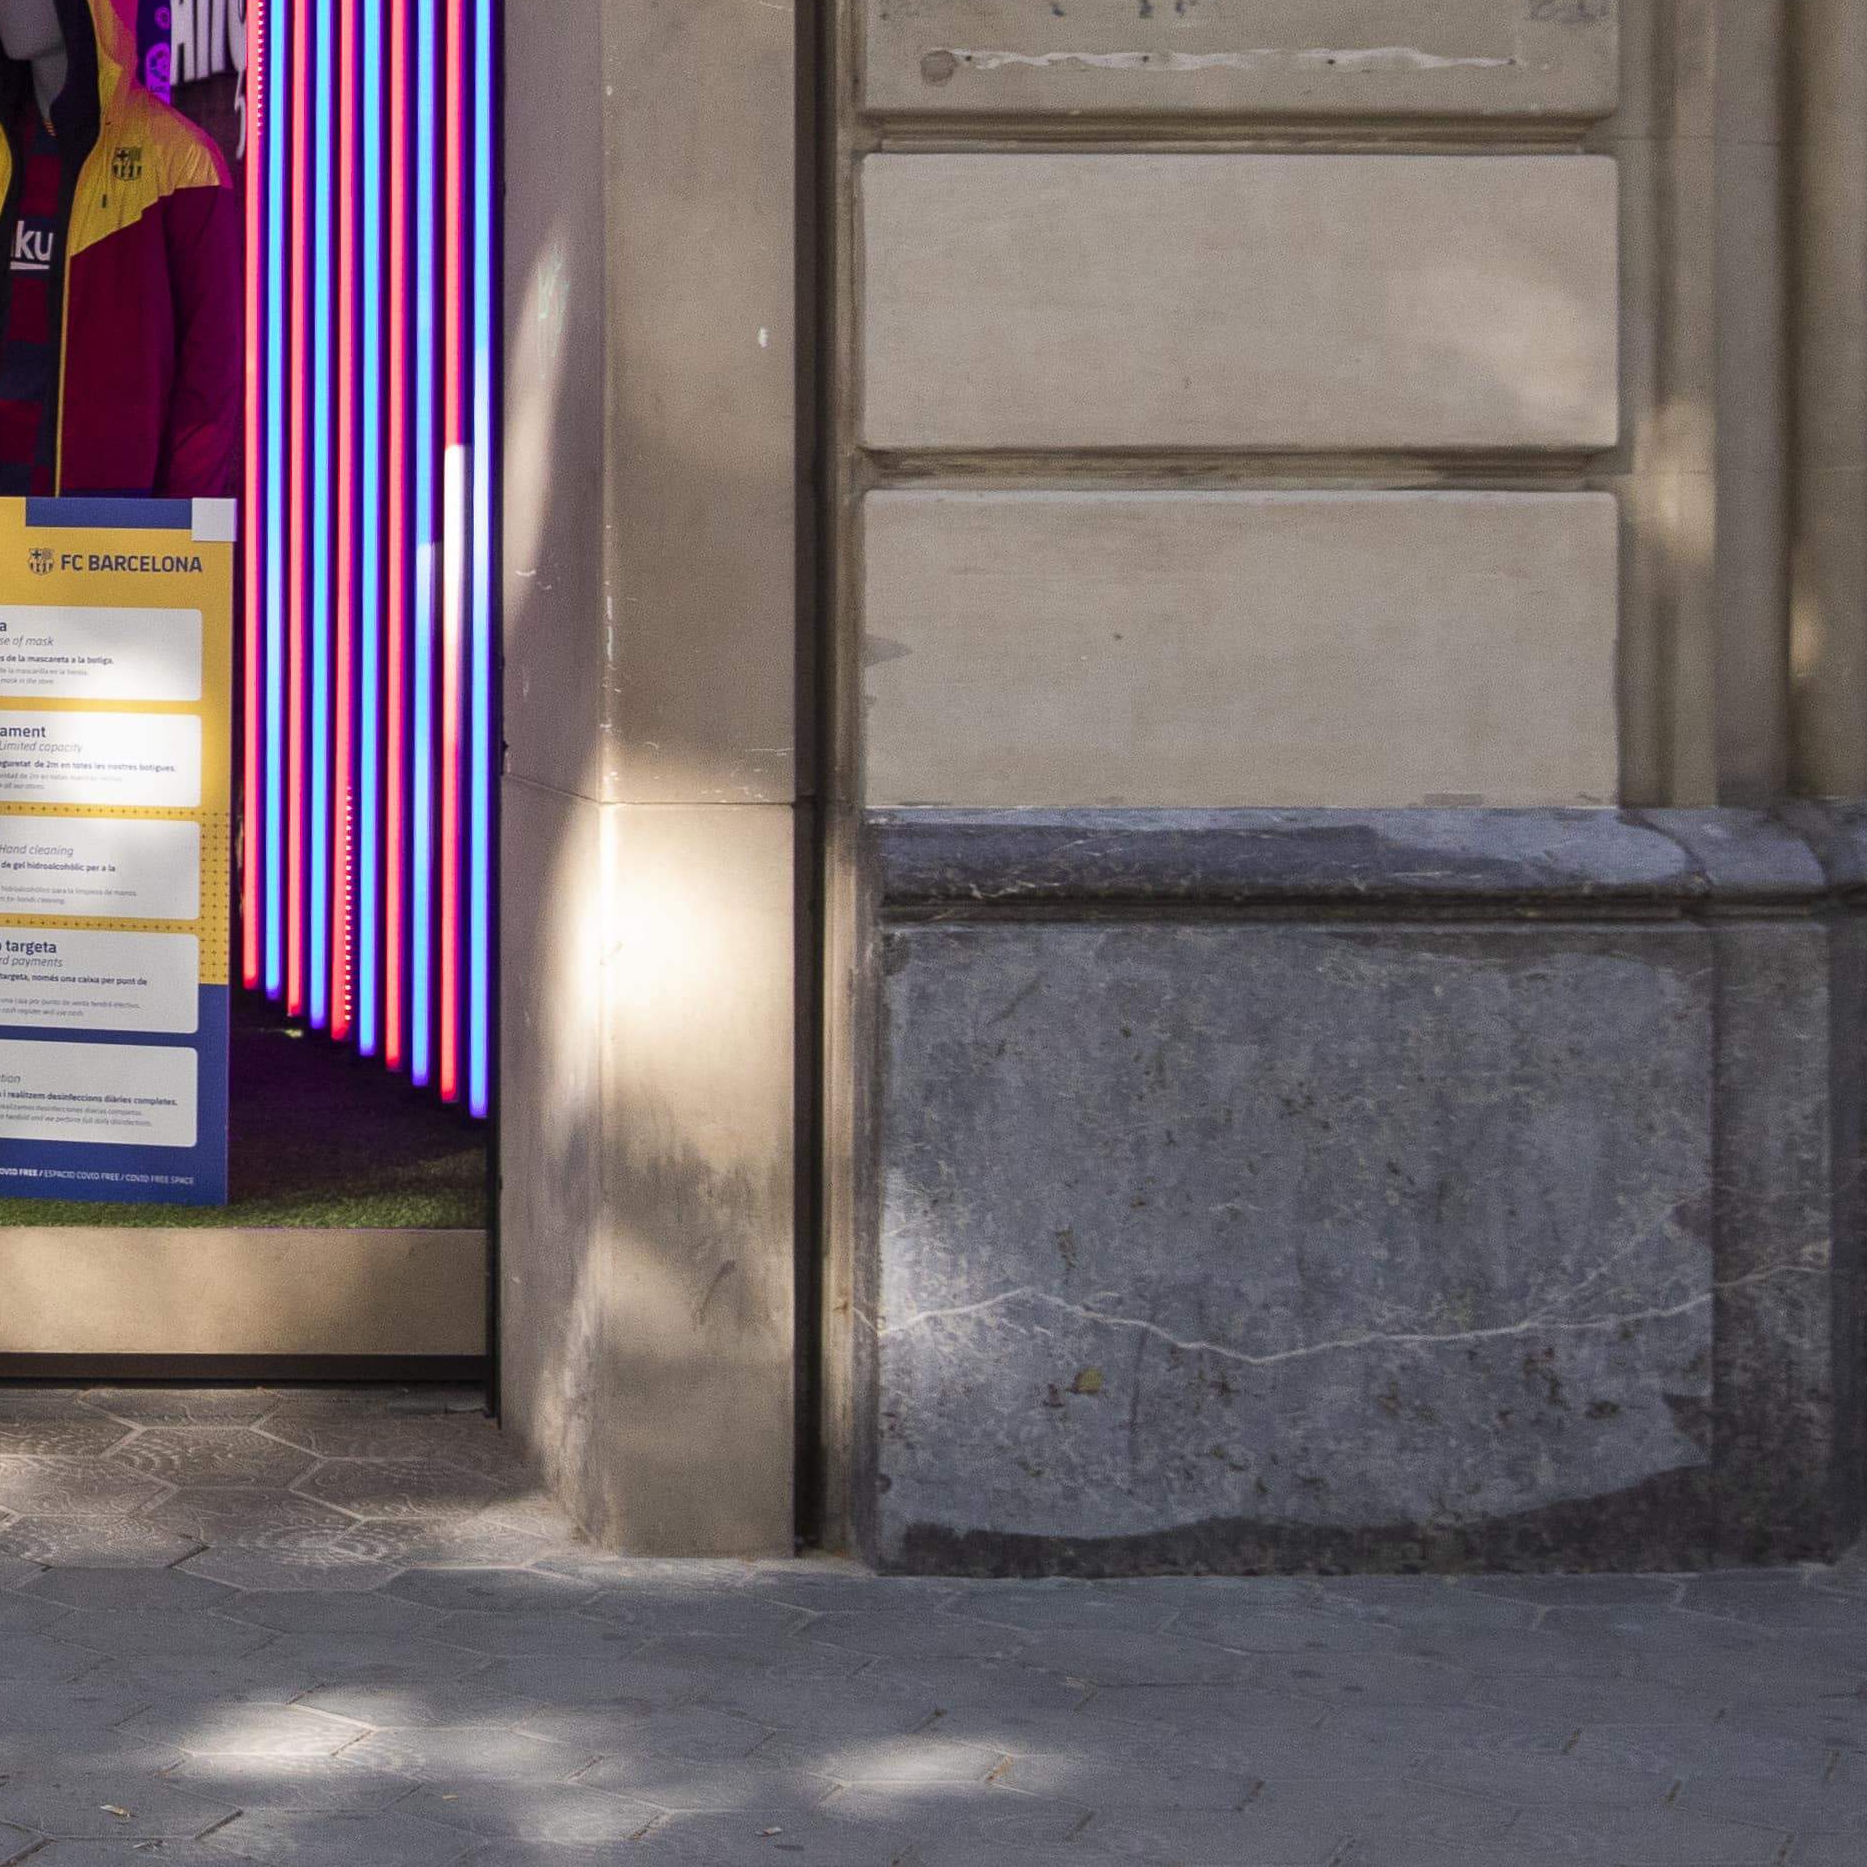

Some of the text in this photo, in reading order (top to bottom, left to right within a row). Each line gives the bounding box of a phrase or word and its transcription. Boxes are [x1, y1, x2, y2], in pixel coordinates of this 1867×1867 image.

[10, 220, 54, 262] ku
[61, 554, 202, 573] FC BARCELONA
[12, 635, 24, 647] of
[25, 636, 54, 646] mask
[0, 844, 26, 854] Hand
[29, 845, 74, 858] cleaning
[5, 940, 57, 955] targeta
[11, 957, 63, 969] payments
